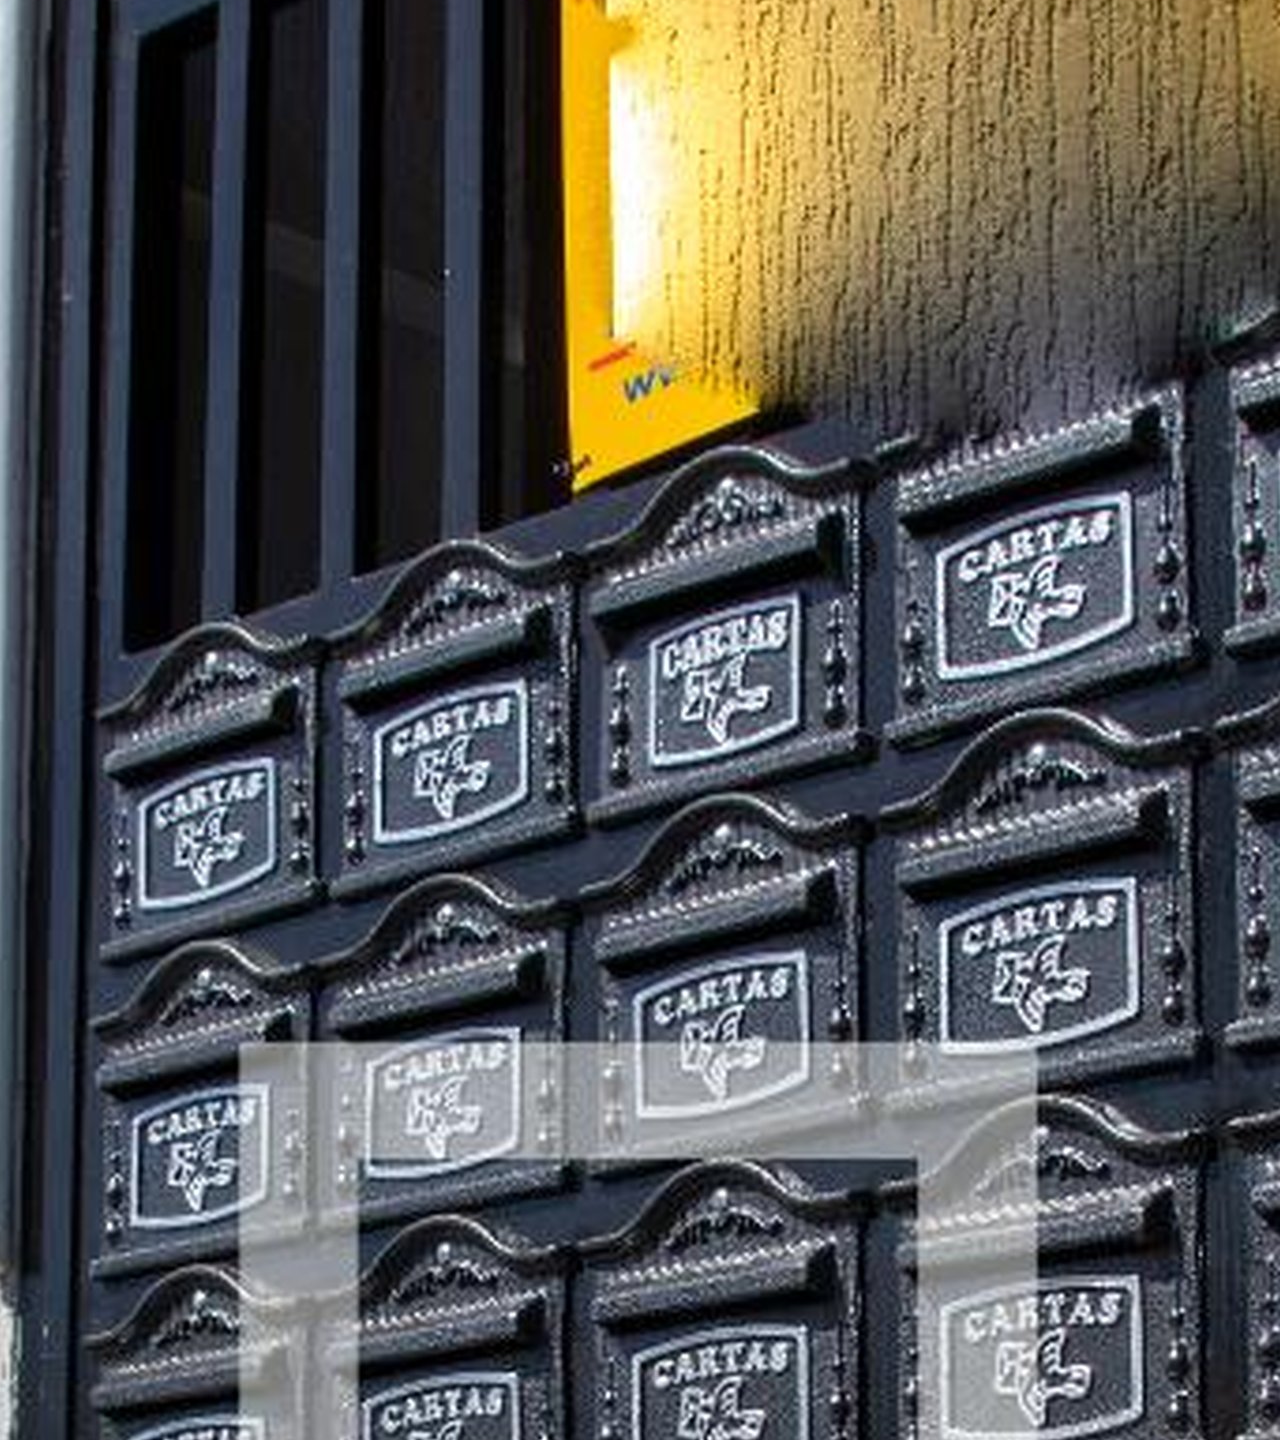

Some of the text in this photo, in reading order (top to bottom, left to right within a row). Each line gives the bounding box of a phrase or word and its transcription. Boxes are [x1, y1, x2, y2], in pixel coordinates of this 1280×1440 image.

[959, 510, 1114, 581] CARTAS
[662, 612, 788, 679] CARTAS
[390, 698, 511, 755] CARTAS
[154, 767, 267, 828] CARTAS
[961, 896, 1117, 956] CARTAS
[654, 968, 788, 1024] CARTAS
[385, 1042, 507, 1090] CARTAS
[147, 1099, 256, 1144] CARTAS
[964, 1292, 1121, 1341] CARTAS
[653, 1342, 790, 1388] CARTAS
[381, 1388, 503, 1433] CARTAS
